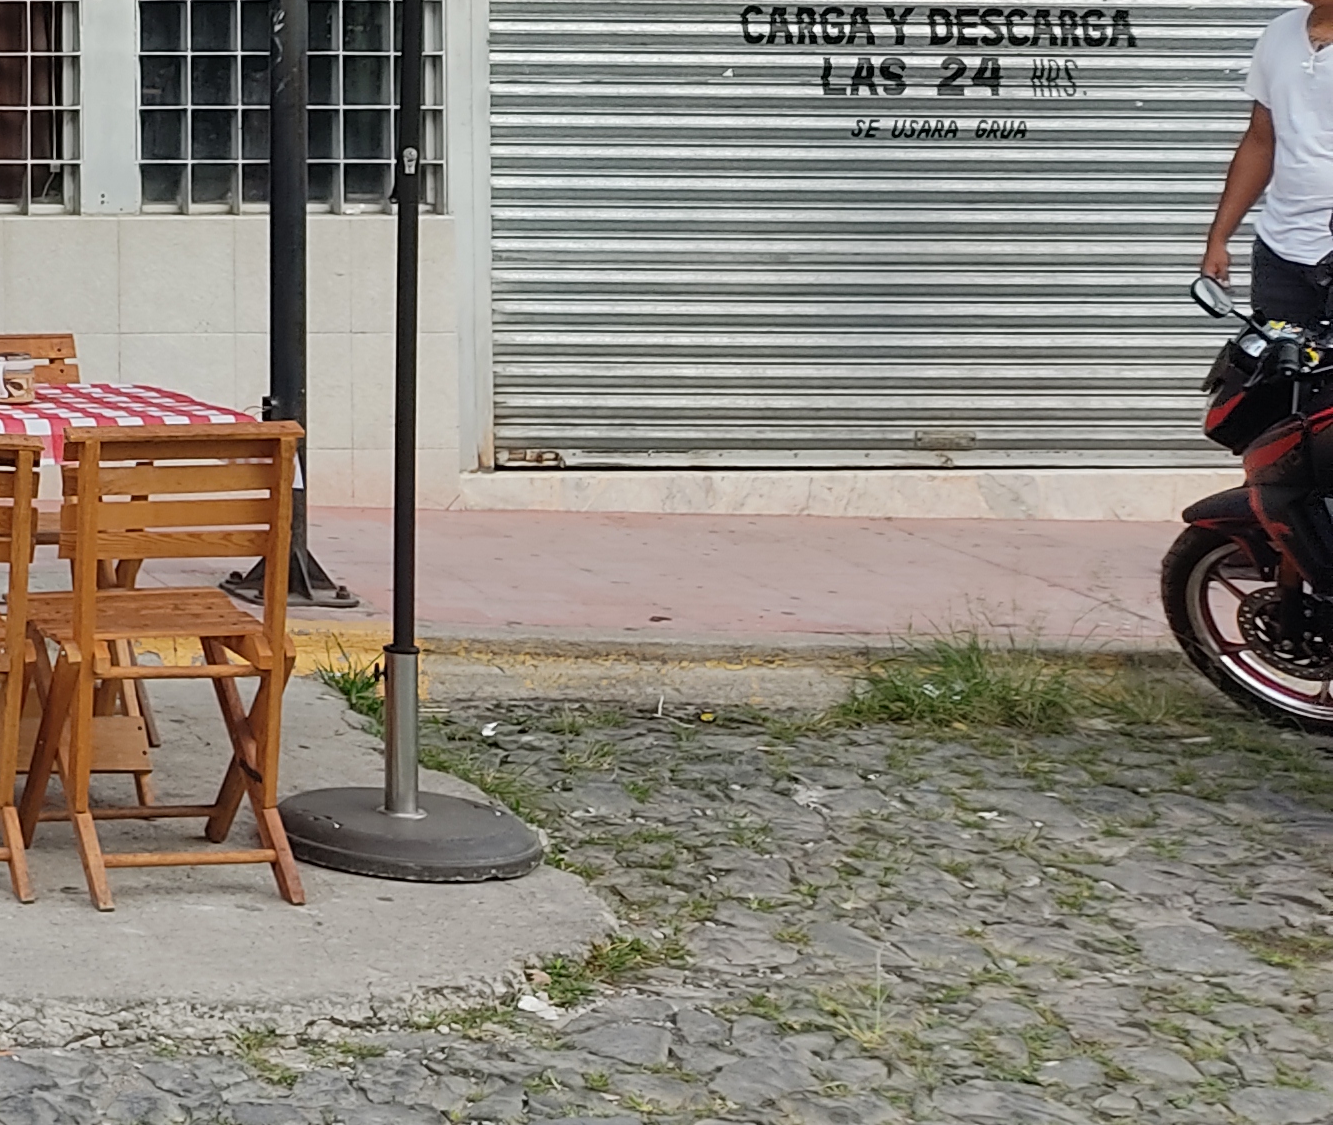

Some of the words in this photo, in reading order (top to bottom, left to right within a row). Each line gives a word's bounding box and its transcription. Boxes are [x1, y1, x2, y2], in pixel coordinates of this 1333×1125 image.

[740, 5, 874, 46] CARGA
[882, 7, 915, 45] Y
[928, 6, 1137, 48] DESCARGA
[820, 57, 907, 96] LAS
[936, 57, 1004, 96] 24
[1031, 58, 1088, 97] HRS.
[851, 119, 880, 138] SE
[891, 119, 960, 139] USARA
[974, 119, 1028, 139] GRUA
